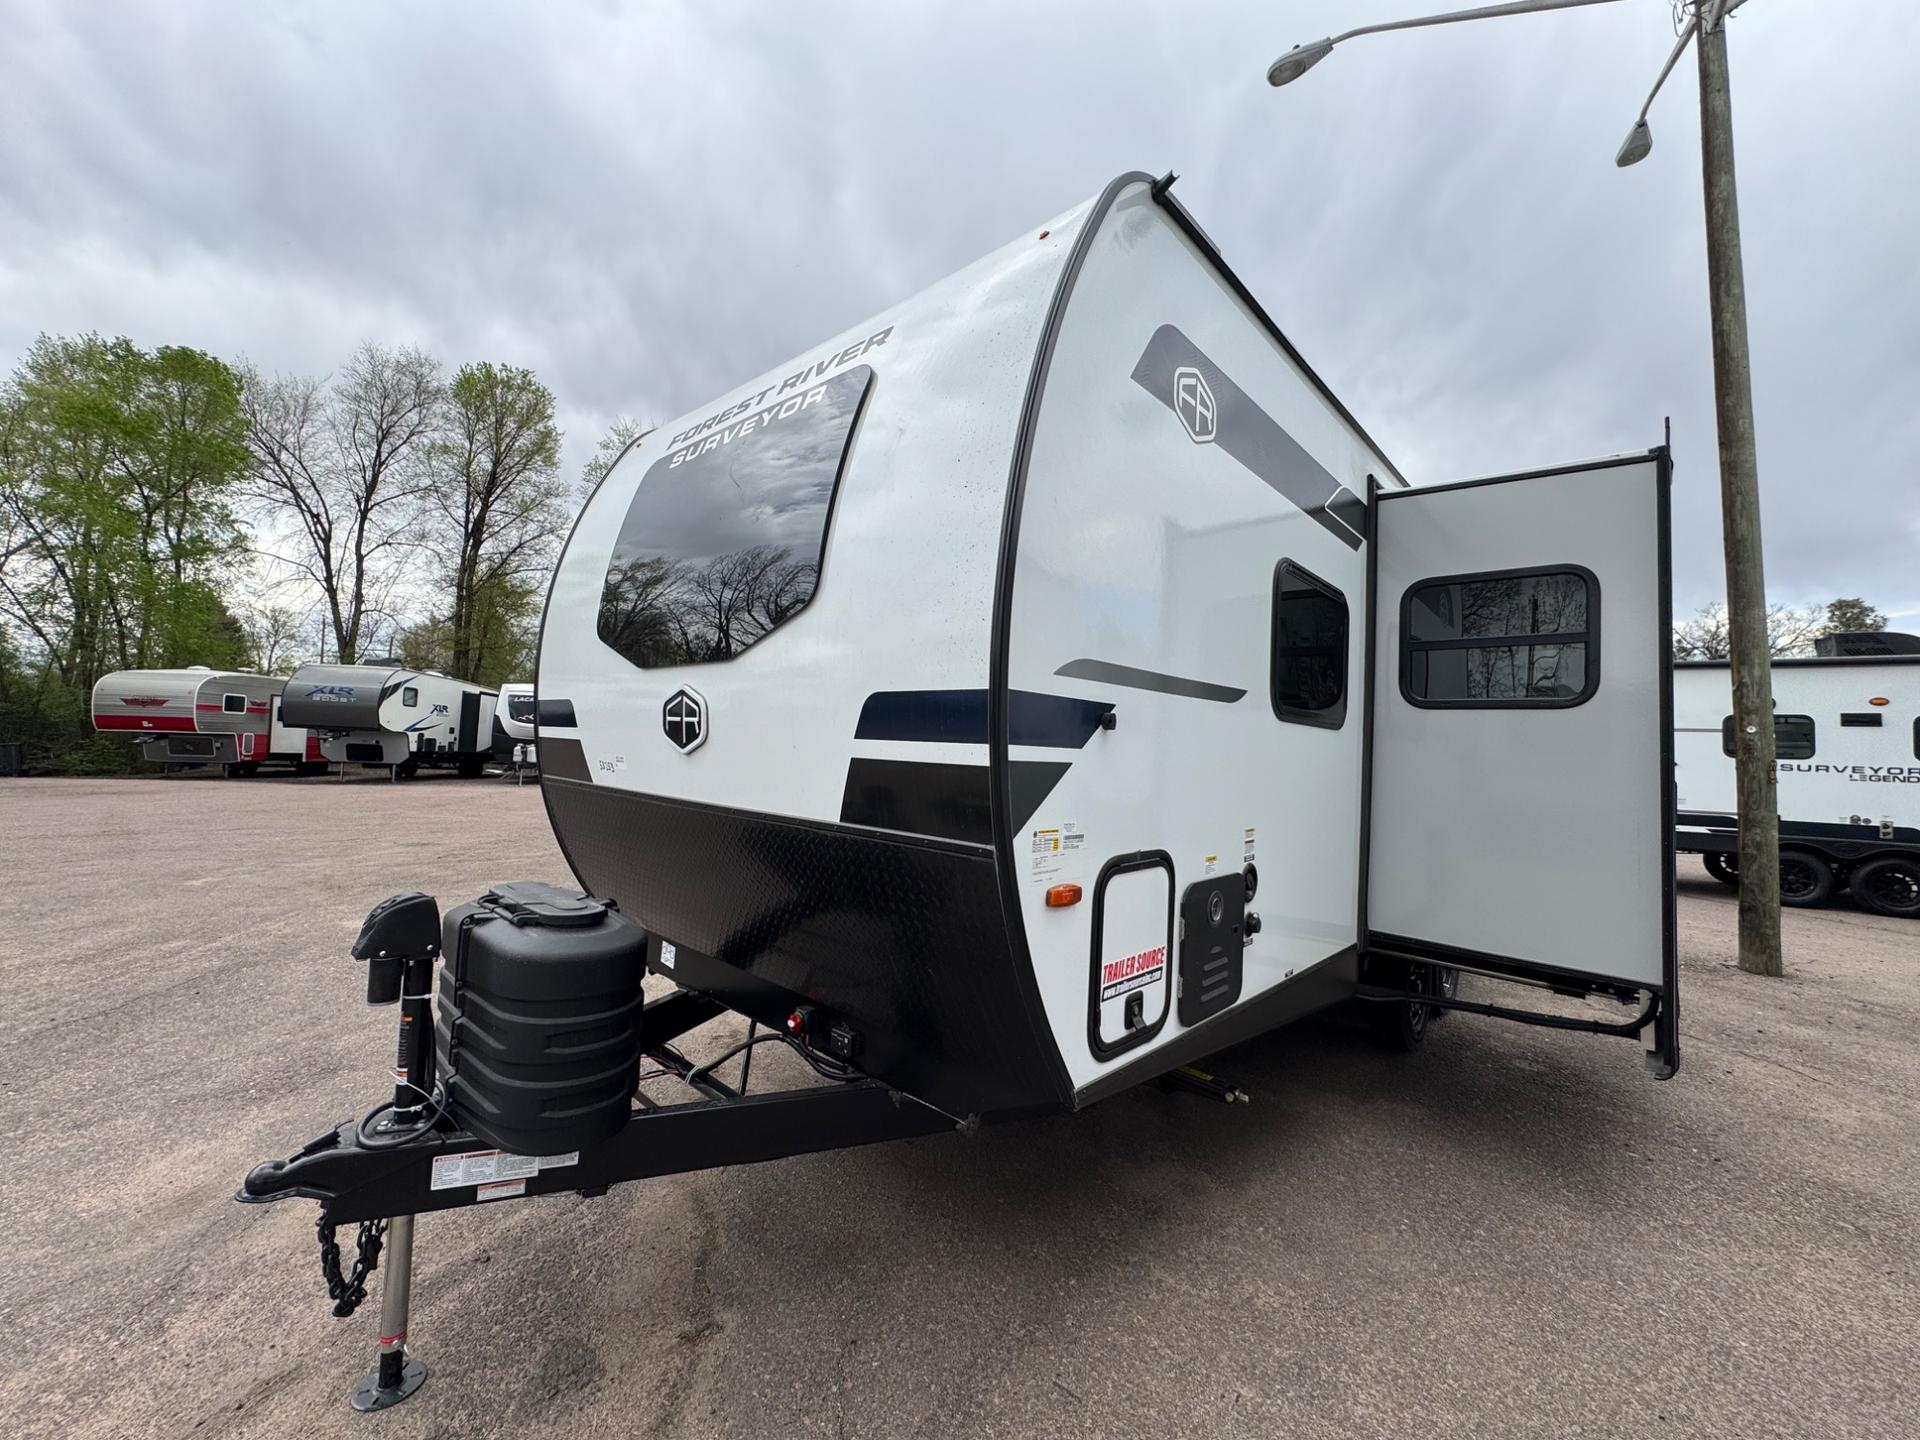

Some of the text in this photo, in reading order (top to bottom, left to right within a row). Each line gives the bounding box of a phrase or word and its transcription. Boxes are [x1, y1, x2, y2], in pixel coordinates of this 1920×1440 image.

[666, 325, 895, 450] FOREST RIVER
[669, 384, 828, 469] SURVEYOR
[304, 685, 354, 697] XLR
[430, 704, 449, 714] XLR
[1779, 763, 1920, 776] SURVEYOR
[1848, 773, 1920, 784] LEGEND
[1102, 946, 1165, 985] TRAILER SOURCE
